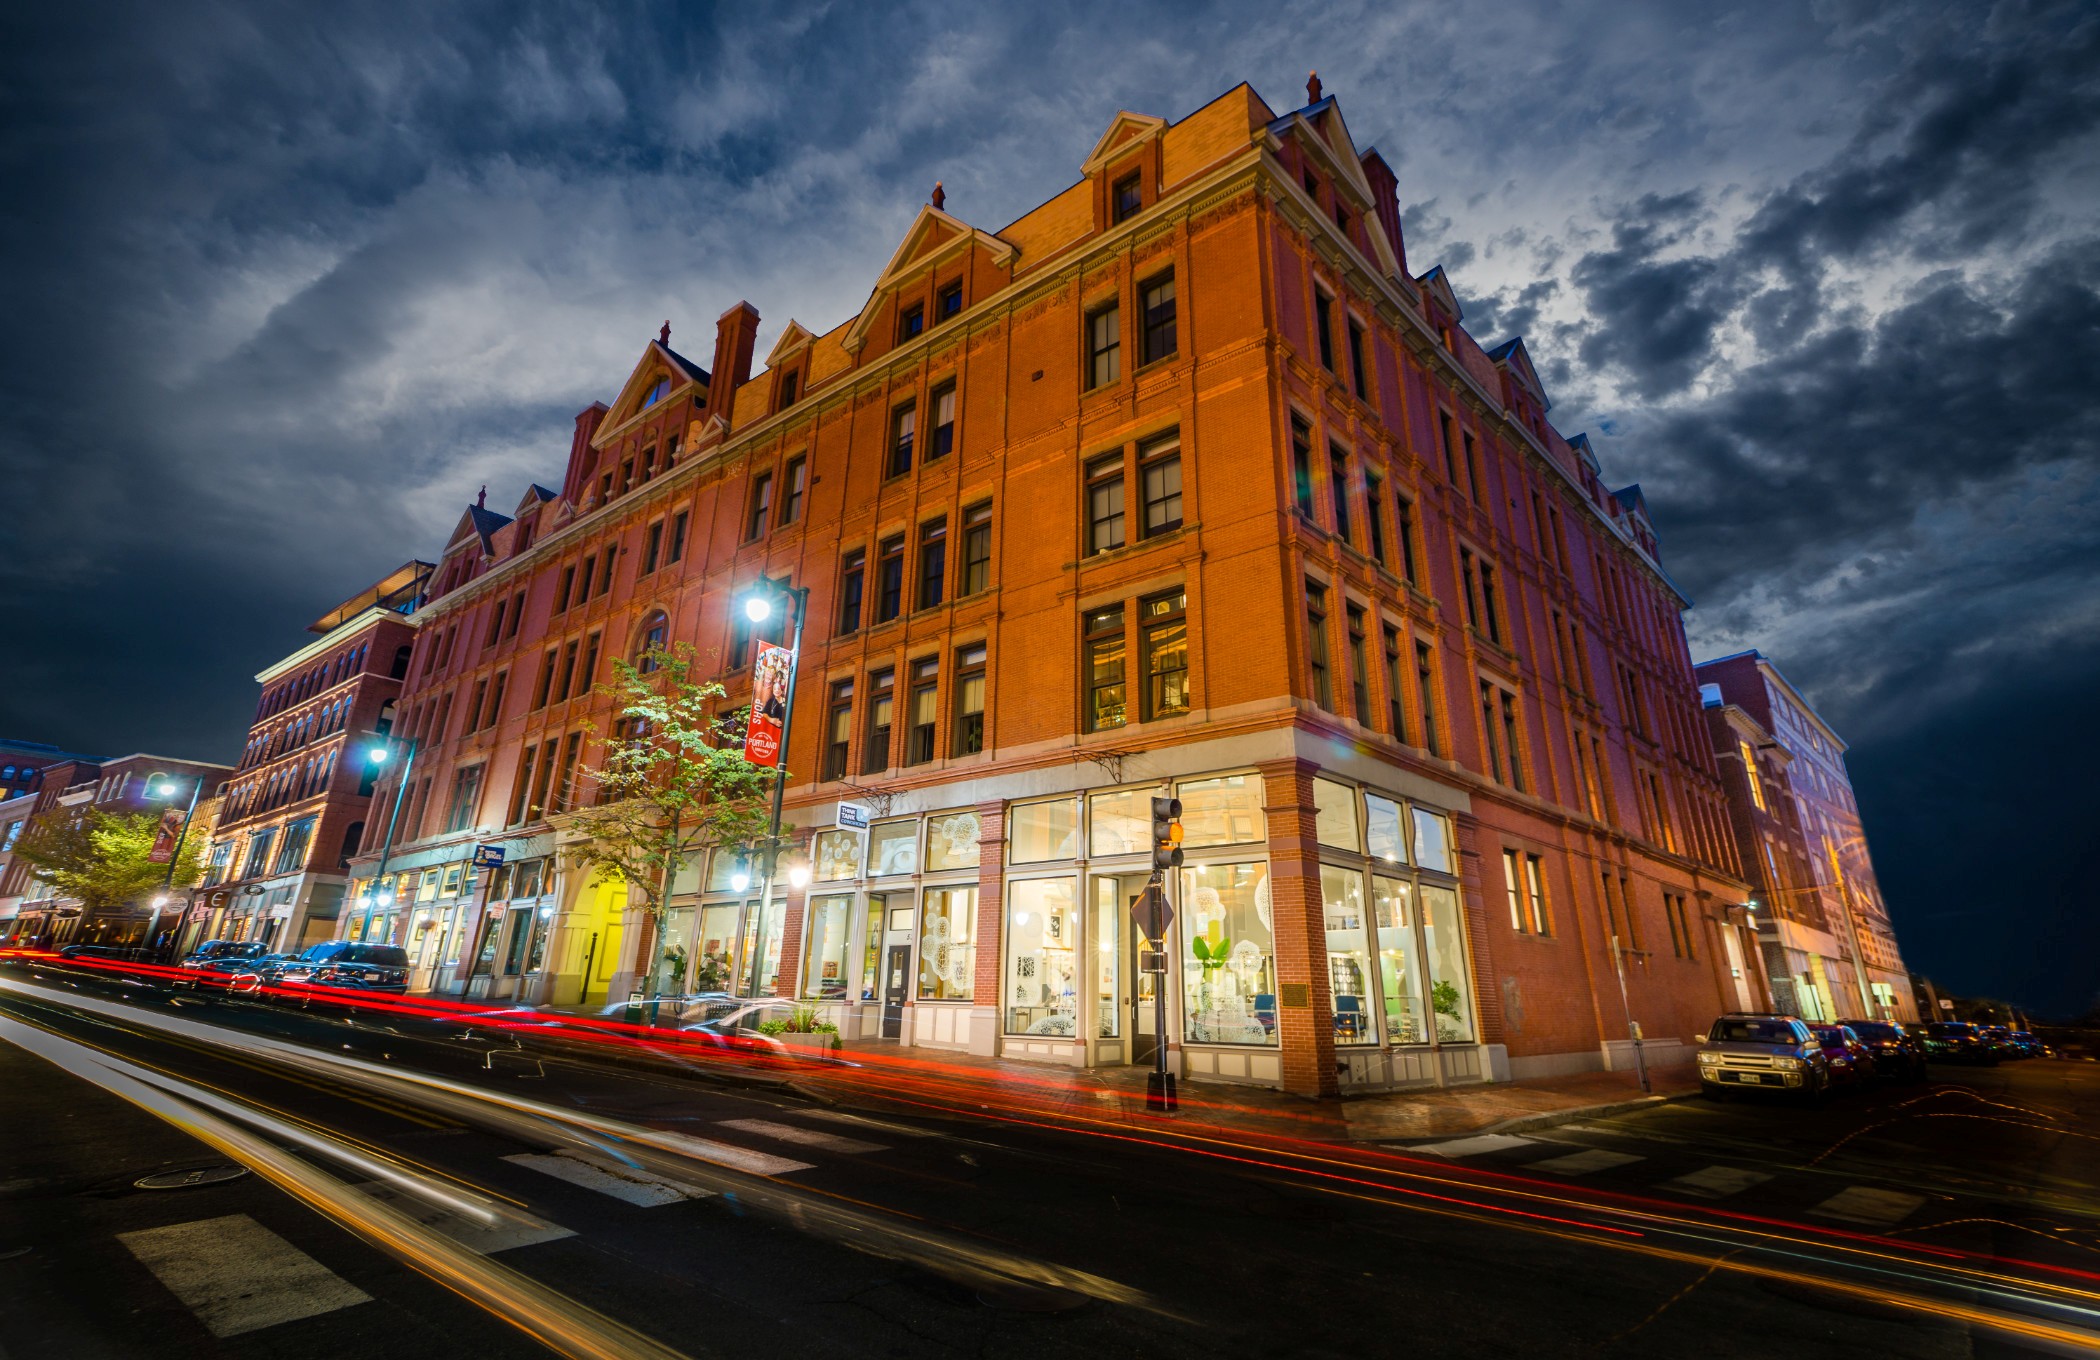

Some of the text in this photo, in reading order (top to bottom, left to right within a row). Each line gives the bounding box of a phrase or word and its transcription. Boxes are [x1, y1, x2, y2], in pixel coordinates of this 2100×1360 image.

[752, 698, 763, 725] SHOP
[748, 737, 777, 750] PORTLAND
[841, 807, 856, 815] THINK
[841, 812, 856, 821] TANK
